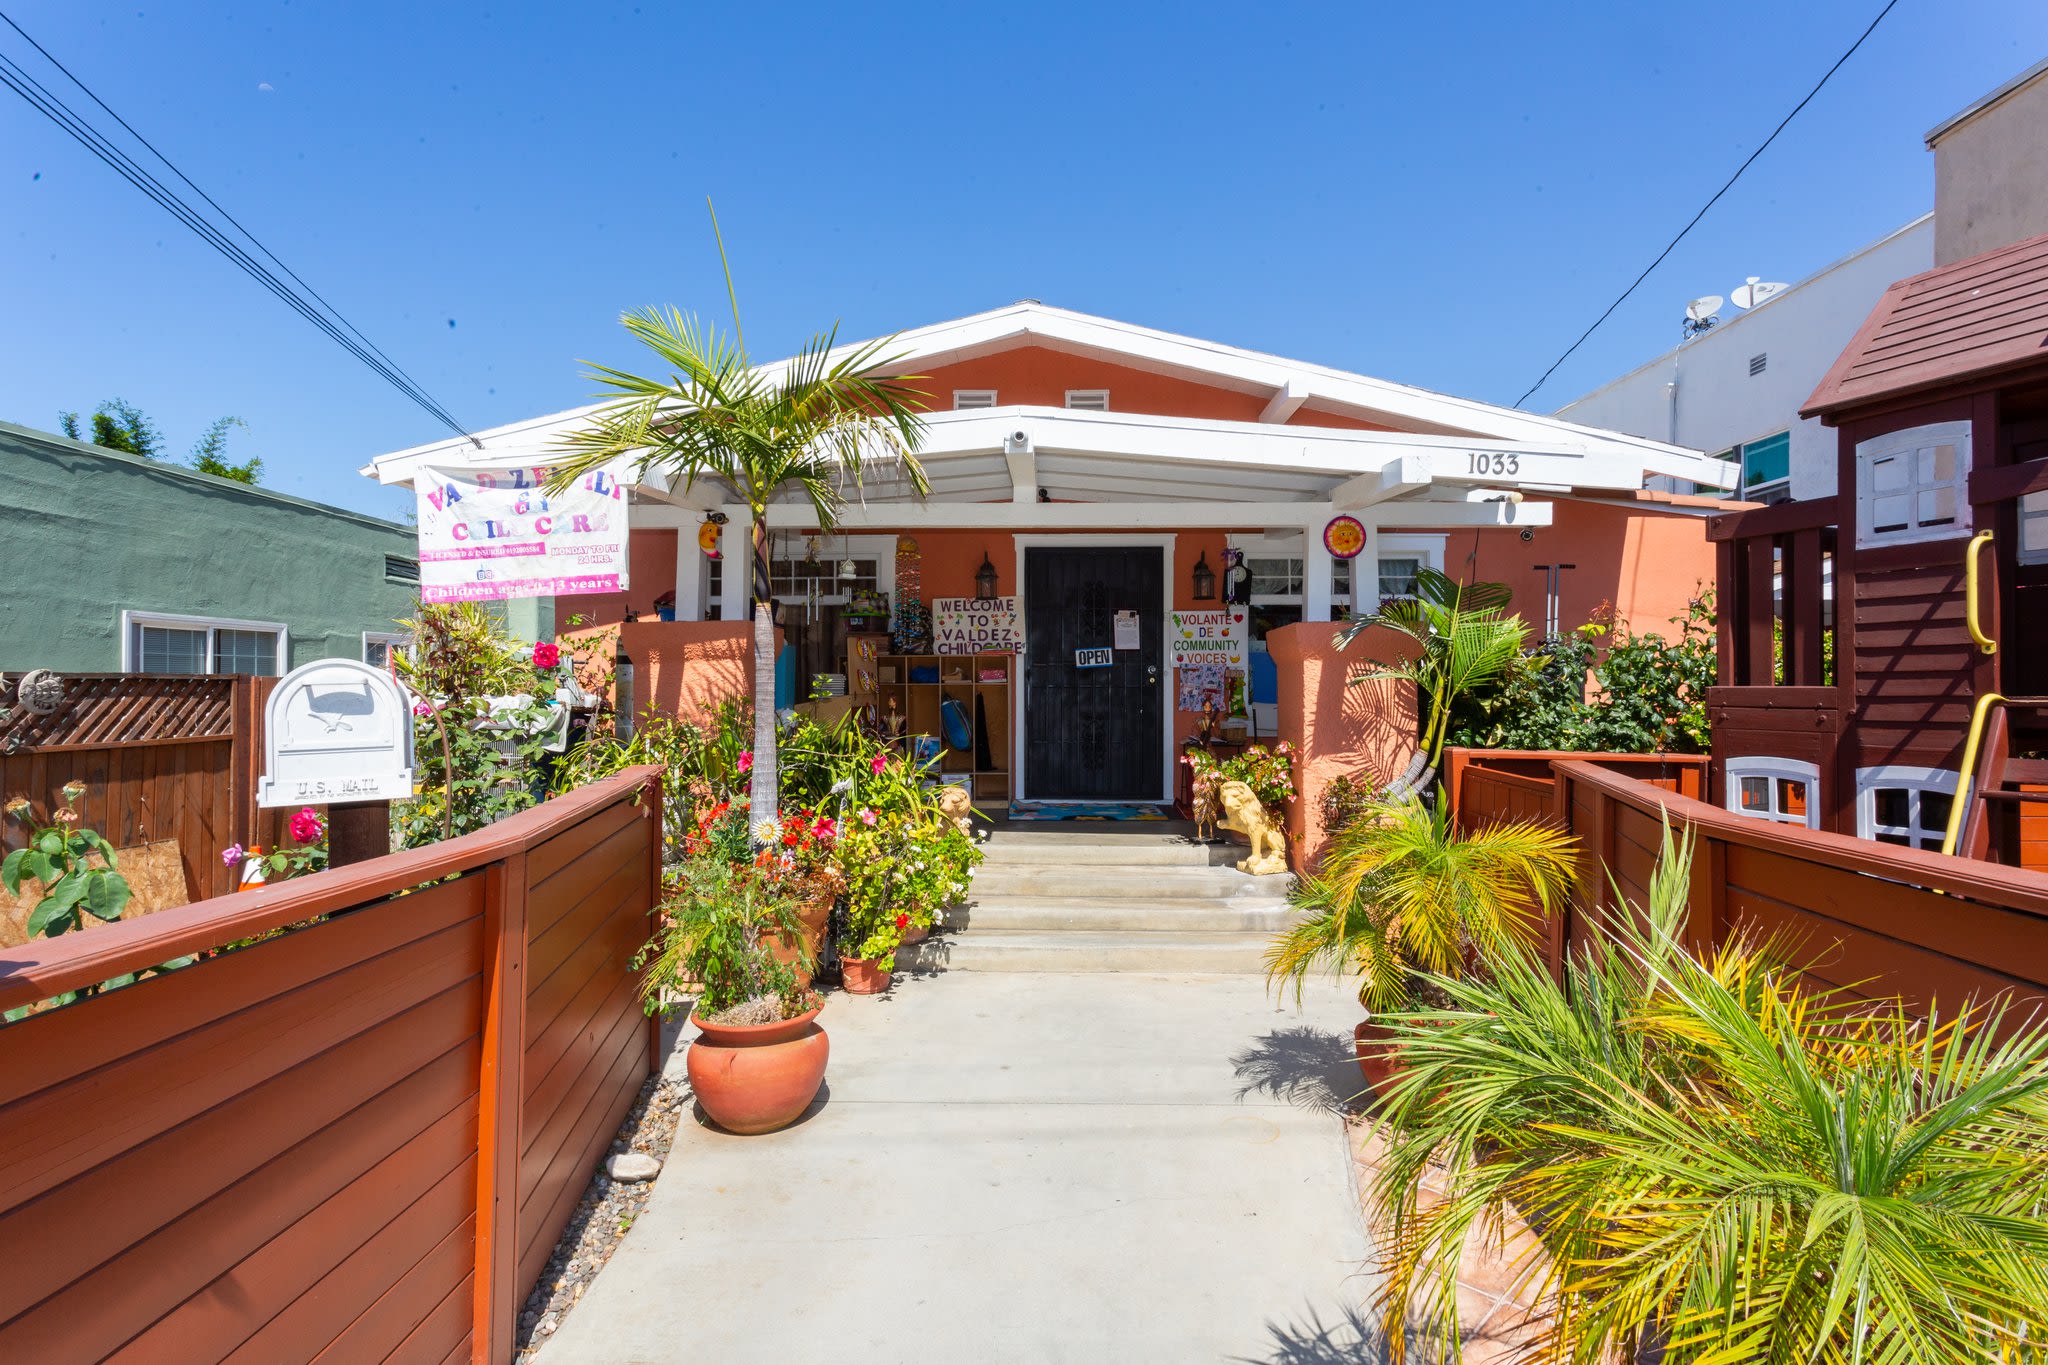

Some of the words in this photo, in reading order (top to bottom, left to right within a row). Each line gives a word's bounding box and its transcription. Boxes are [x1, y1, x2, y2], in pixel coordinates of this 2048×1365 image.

[1468, 452, 1520, 475] 1033
[427, 469, 530, 511] VADZ
[452, 517, 526, 541] CIL
[535, 513, 610, 536] CRE
[468, 549, 475, 557] &
[551, 546, 589, 556] MONDAY
[591, 545, 603, 554] TO
[578, 556, 589, 564] 24
[591, 555, 613, 564] HRS.
[426, 585, 493, 598] Children
[498, 583, 531, 595] ages
[570, 579, 612, 591] years
[941, 599, 1014, 612] WELCOME
[968, 615, 989, 626] TO
[1181, 614, 1232, 625] VOLANTE
[942, 629, 1012, 641] VALDEZ
[1199, 627, 1214, 637] DE
[1173, 640, 1239, 651] COMMUNITY
[1078, 650, 1110, 665] OPEN
[1187, 653, 1227, 664] VOICES
[297, 781, 332, 795] U.S.
[342, 778, 379, 792] MAIL
